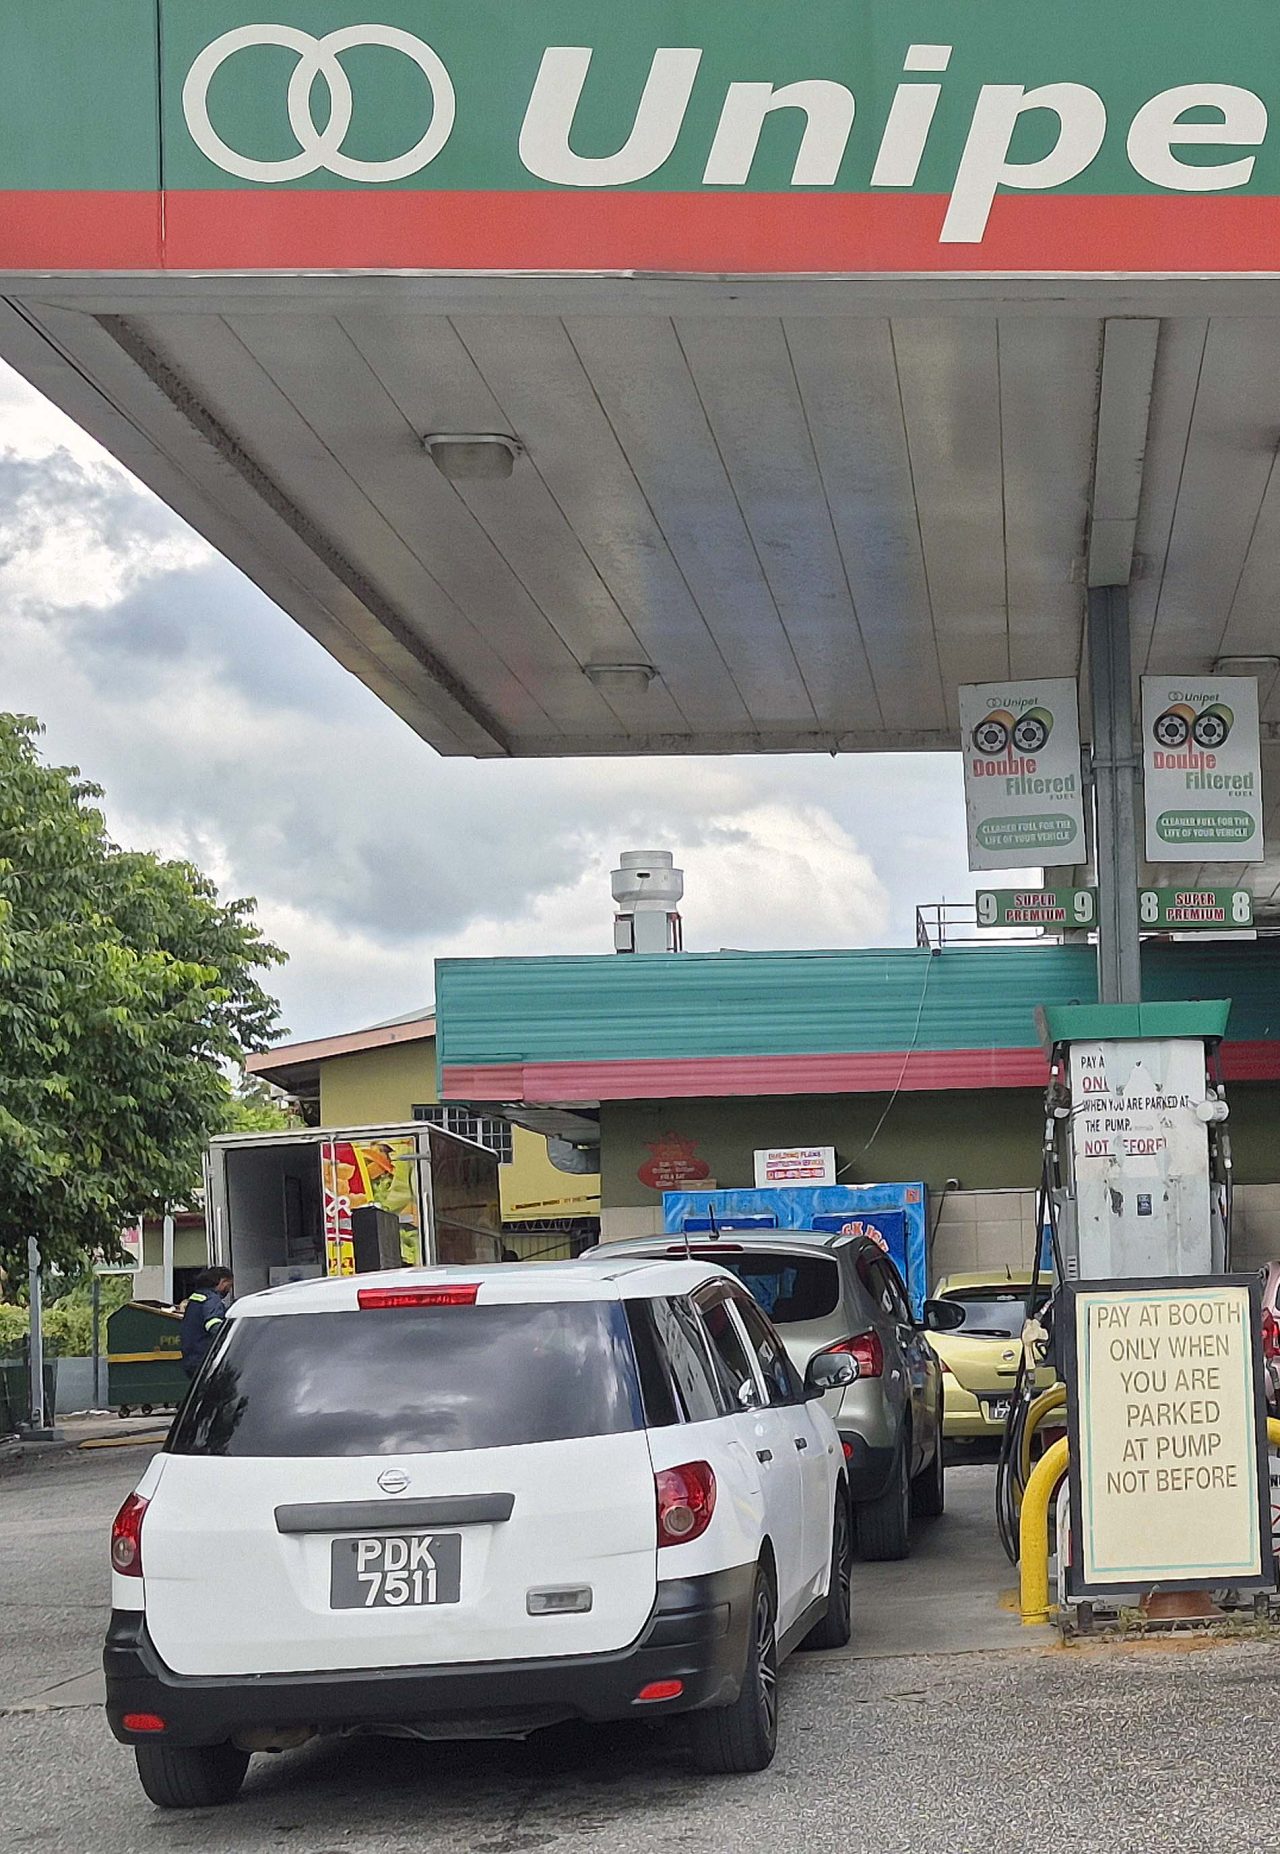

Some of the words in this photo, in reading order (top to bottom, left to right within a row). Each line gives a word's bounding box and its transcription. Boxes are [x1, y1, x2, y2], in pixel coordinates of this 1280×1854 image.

[1003, 696, 1038, 711] Unipet
[1184, 692, 1219, 706] Unipet
[973, 752, 1036, 777] Double
[1153, 747, 1216, 771] Double
[1006, 774, 1075, 796] Filtered
[1185, 769, 1254, 790] Filtered
[1215, 827, 1248, 837] VEHICLE
[978, 892, 998, 924] 9
[1014, 893, 1056, 906] SUPER
[1074, 891, 1093, 923] 9
[1006, 908, 1065, 922] PREMIUM
[1141, 891, 1159, 923] 8
[1175, 892, 1215, 906] SUPER
[1232, 891, 1250, 923] 8
[1167, 906, 1224, 921] PREMIUM
[1081, 1056, 1097, 1069] PAY
[1108, 1098, 1125, 1111] YOU
[1126, 1097, 1143, 1110] ARE
[1180, 1095, 1190, 1108] AT
[1085, 1119, 1101, 1132] THE
[1085, 1140, 1110, 1154] NOT
[1097, 1305, 1130, 1329] PAY
[1139, 1304, 1161, 1327] AT
[1168, 1302, 1241, 1326] BOOTH
[1110, 1337, 1161, 1362] ONLY
[1168, 1334, 1229, 1360] WHEN
[1120, 1370, 1167, 1394] YOU
[1175, 1367, 1220, 1391] ARE
[1126, 1400, 1221, 1428] PARKED
[1123, 1437, 1149, 1462] AT
[1157, 1433, 1222, 1459] PUMP
[1107, 1469, 1150, 1494] NOT
[1157, 1465, 1238, 1493] BEFORE
[357, 1536, 436, 1572] PDK
[358, 1570, 437, 1606] 7511
